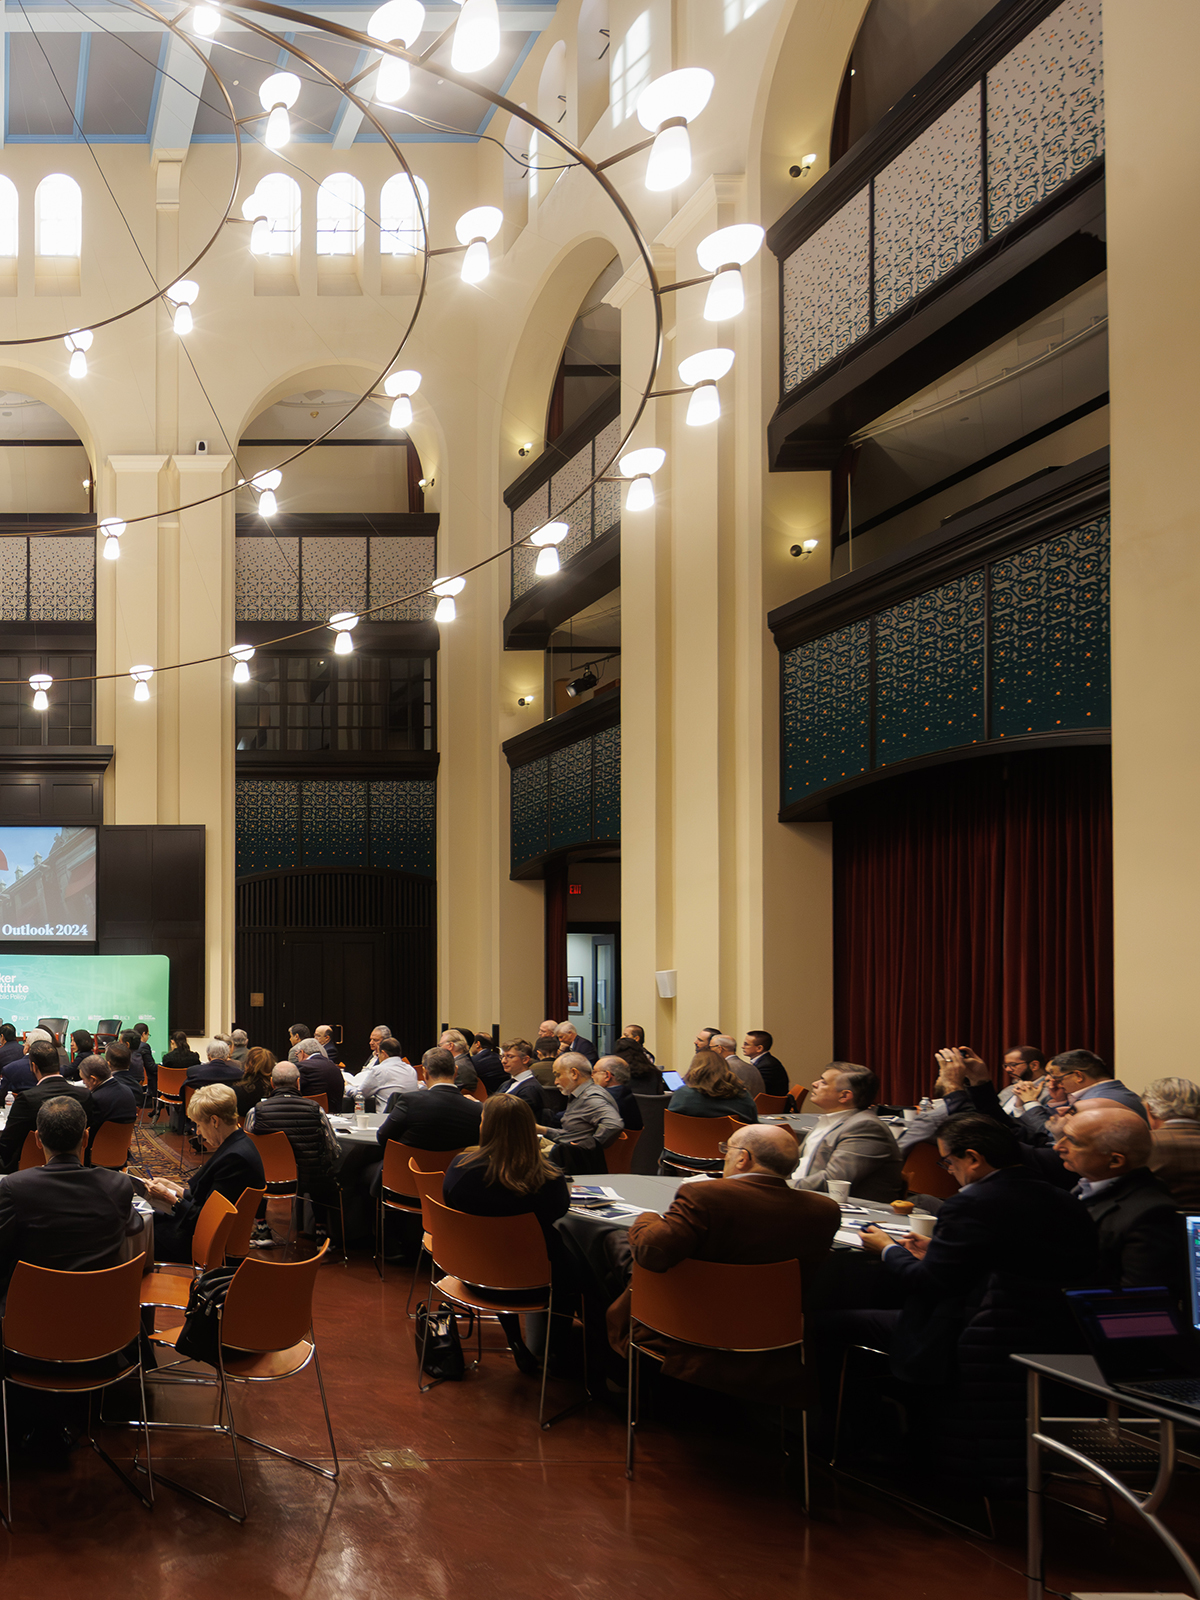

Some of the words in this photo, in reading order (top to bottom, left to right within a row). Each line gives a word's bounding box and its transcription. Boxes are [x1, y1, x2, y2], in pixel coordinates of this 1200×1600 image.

[2, 923, 54, 936] Outlook
[56, 923, 88, 936] 2024
[10, 993, 27, 1001] Policy
